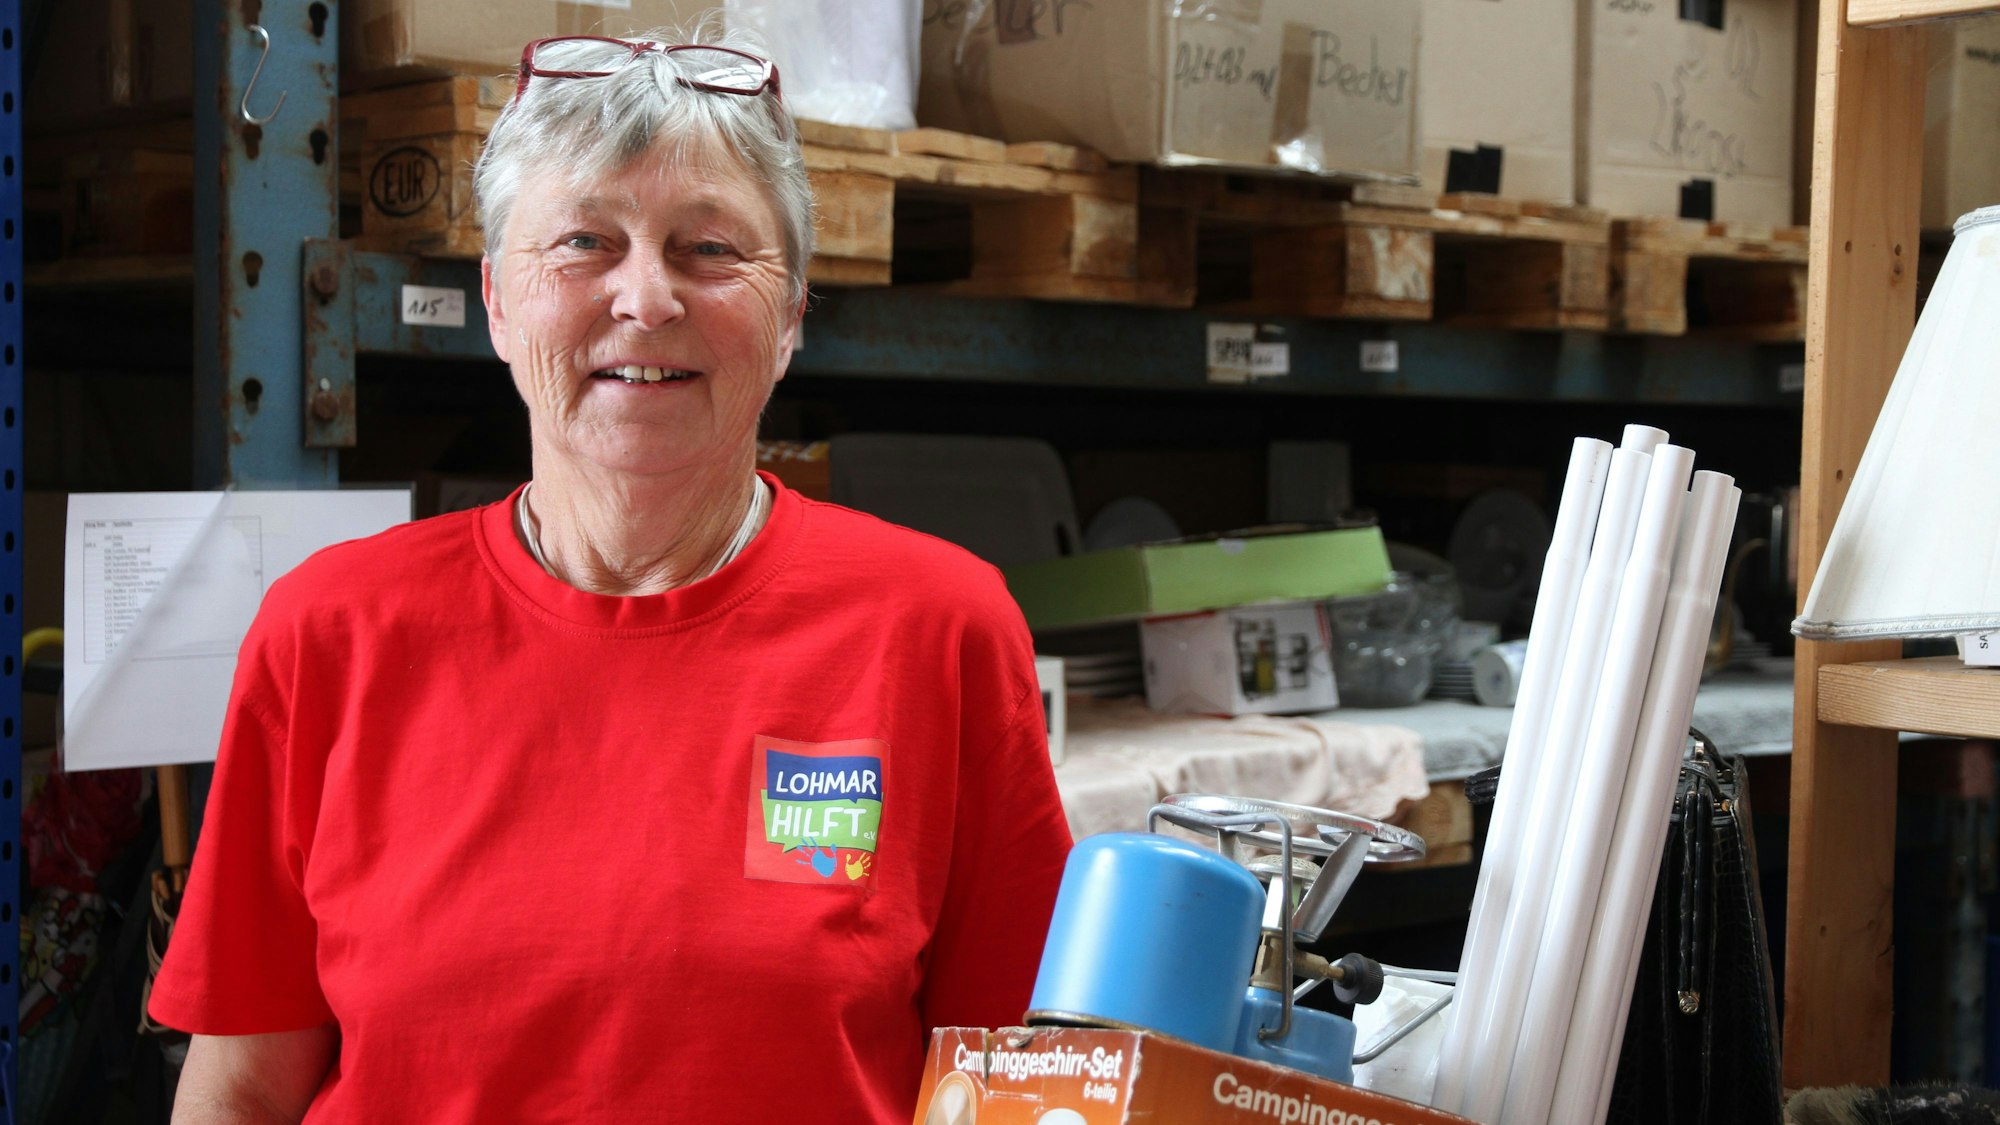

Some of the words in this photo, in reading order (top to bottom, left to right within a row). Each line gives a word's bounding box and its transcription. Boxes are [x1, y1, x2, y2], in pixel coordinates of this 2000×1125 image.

[384, 160, 425, 205] EUR
[408, 298, 444, 319] 115
[776, 769, 877, 796] LOHMAR
[771, 803, 867, 838] HILFT
[955, 1043, 1123, 1080] Campinggeschirr-Set
[1083, 1081, 1118, 1103] 6-teilig
